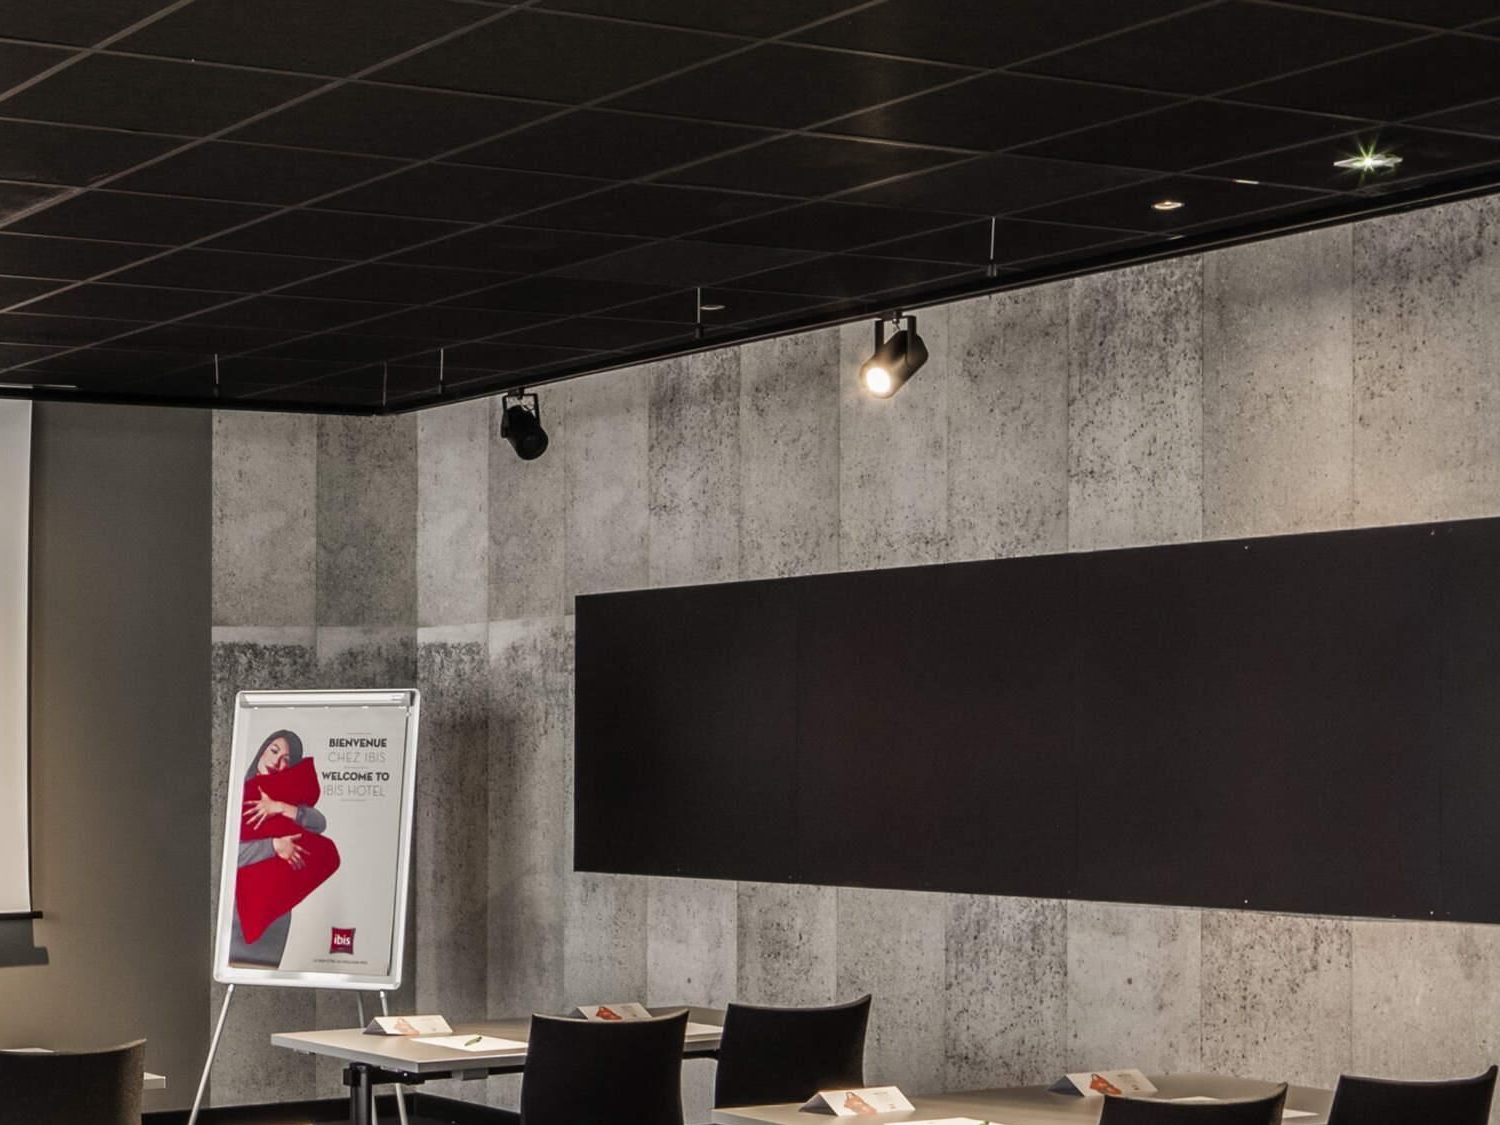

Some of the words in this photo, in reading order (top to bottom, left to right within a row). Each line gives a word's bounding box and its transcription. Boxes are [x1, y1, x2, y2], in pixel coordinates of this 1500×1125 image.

[328, 738, 387, 748] BIENVENUE
[328, 751, 361, 763] CHEZ
[365, 752, 386, 763] IBIS
[322, 772, 373, 781] WELCOME
[376, 772, 390, 781] TO
[324, 784, 343, 796] IBIS
[347, 785, 386, 797] HOTEL
[334, 934, 351, 945] ibis
